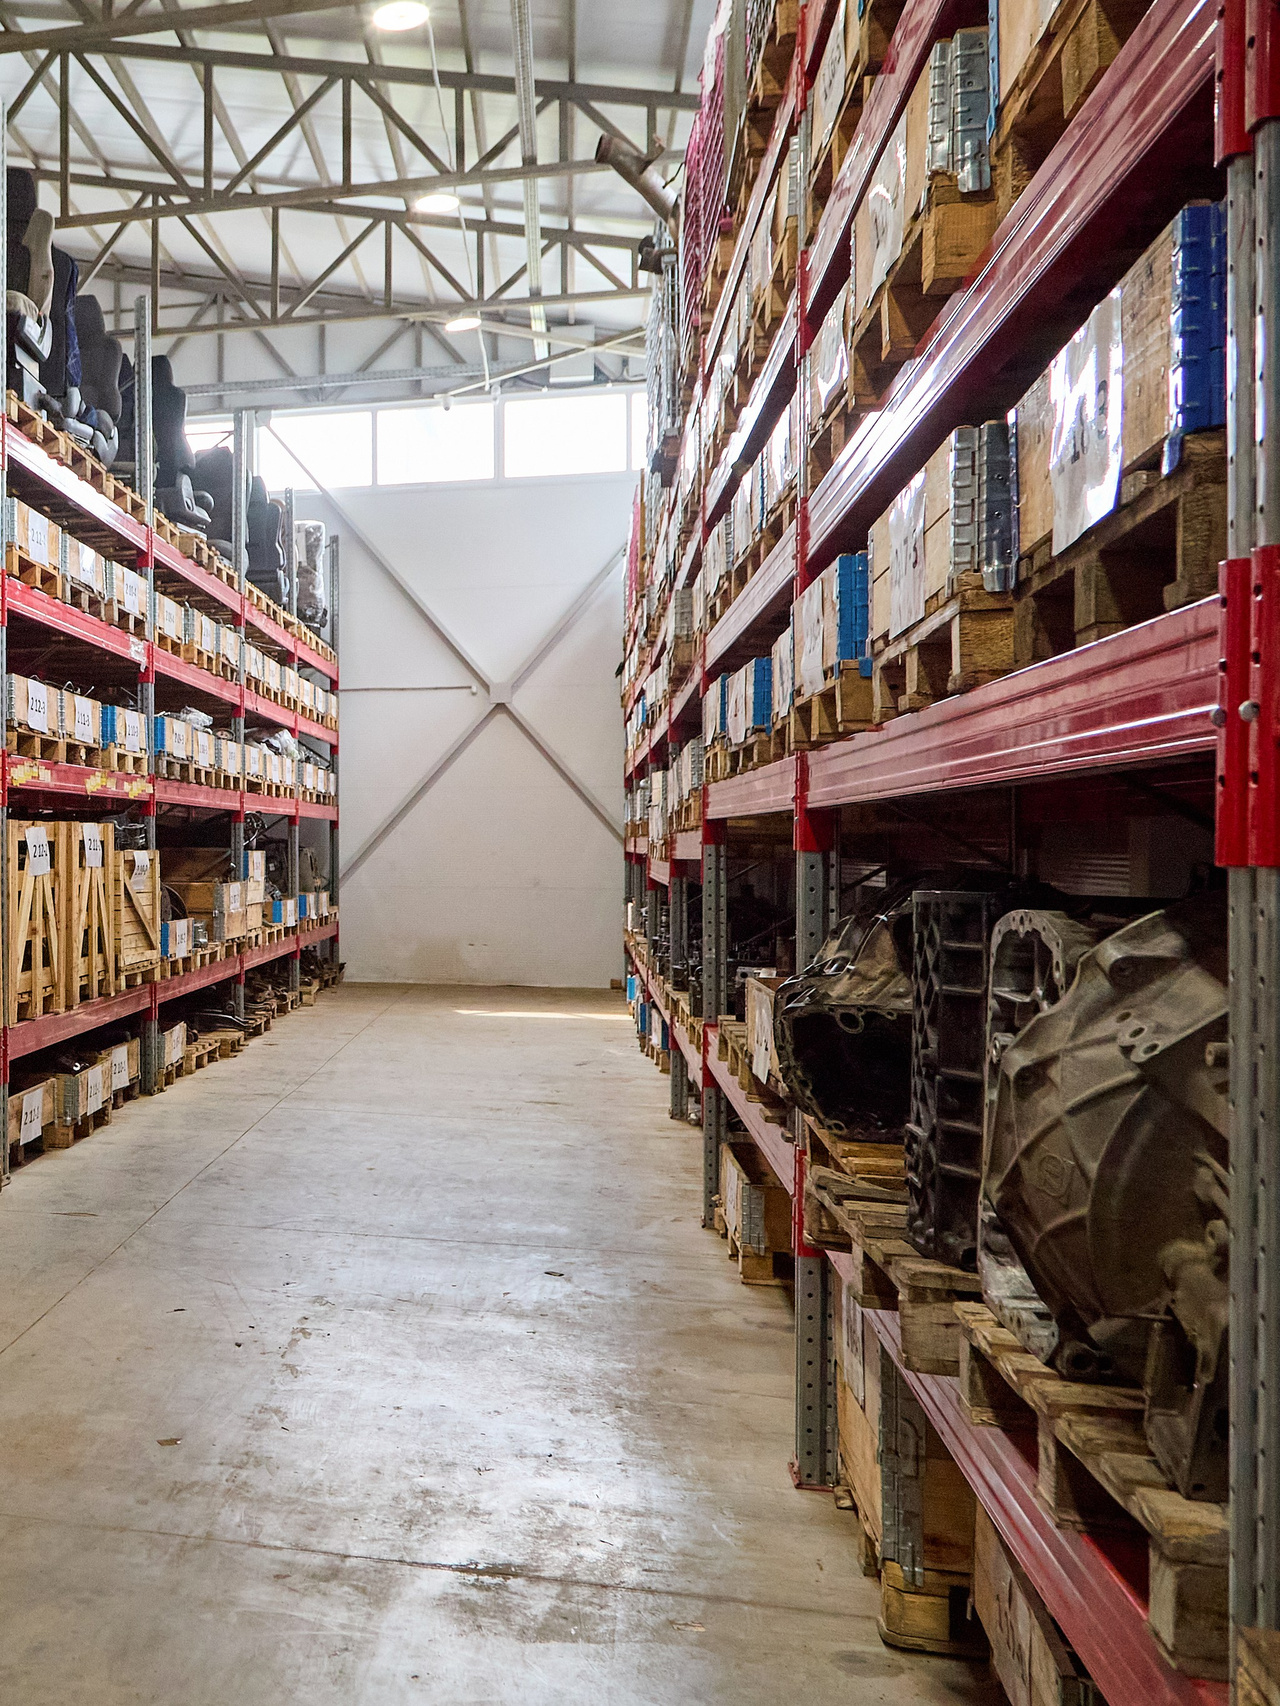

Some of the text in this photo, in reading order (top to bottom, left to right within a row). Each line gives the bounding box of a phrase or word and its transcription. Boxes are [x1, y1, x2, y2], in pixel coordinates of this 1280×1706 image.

[30, 697, 34, 713] 2
[33, 844, 38, 858] 2
[88, 838, 101, 851] 2 11-
[23, 1112, 28, 1125] 2
